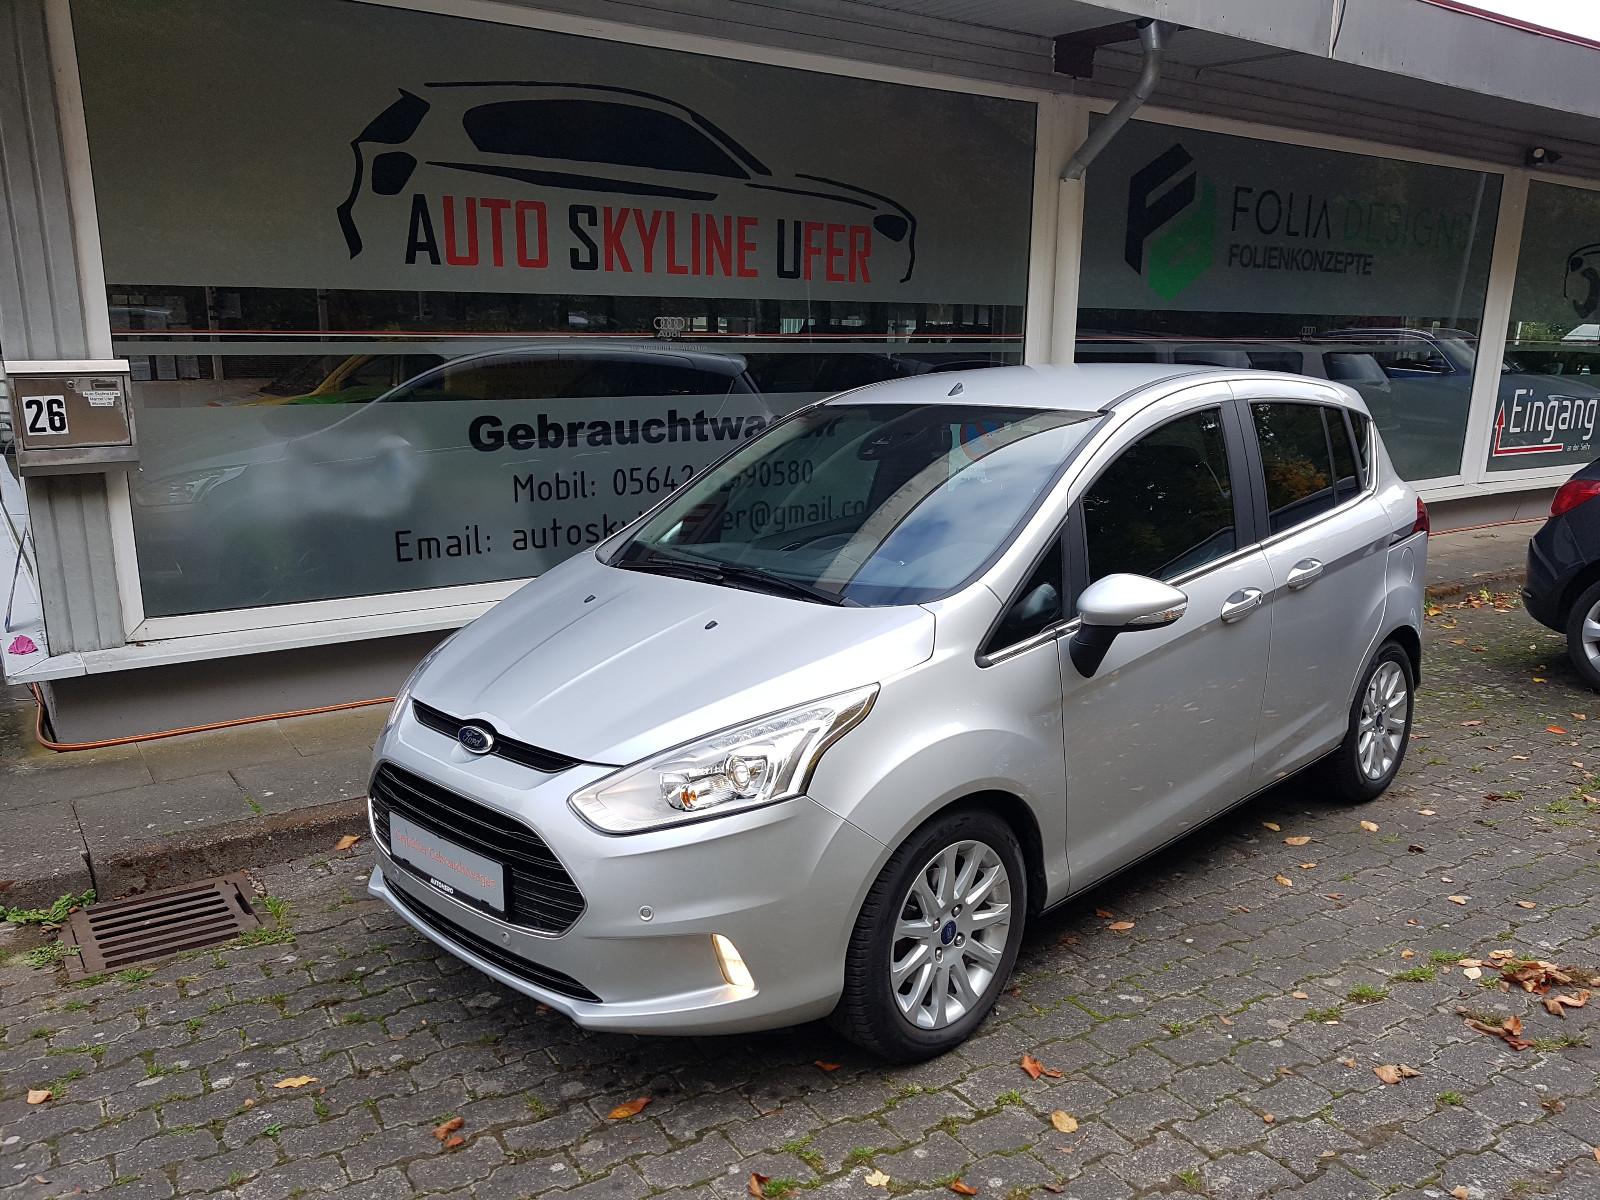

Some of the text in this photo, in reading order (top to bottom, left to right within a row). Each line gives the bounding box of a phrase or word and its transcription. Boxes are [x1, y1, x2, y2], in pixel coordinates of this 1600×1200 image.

[405, 194, 872, 283] AUTO SKYLINE UFER
[1228, 243, 1374, 276] FOLIENKONZEPTE
[25, 398, 67, 433] 26
[1509, 389, 1598, 443] Eingang
[513, 470, 596, 504] Mobil:
[394, 524, 491, 563] Email:
